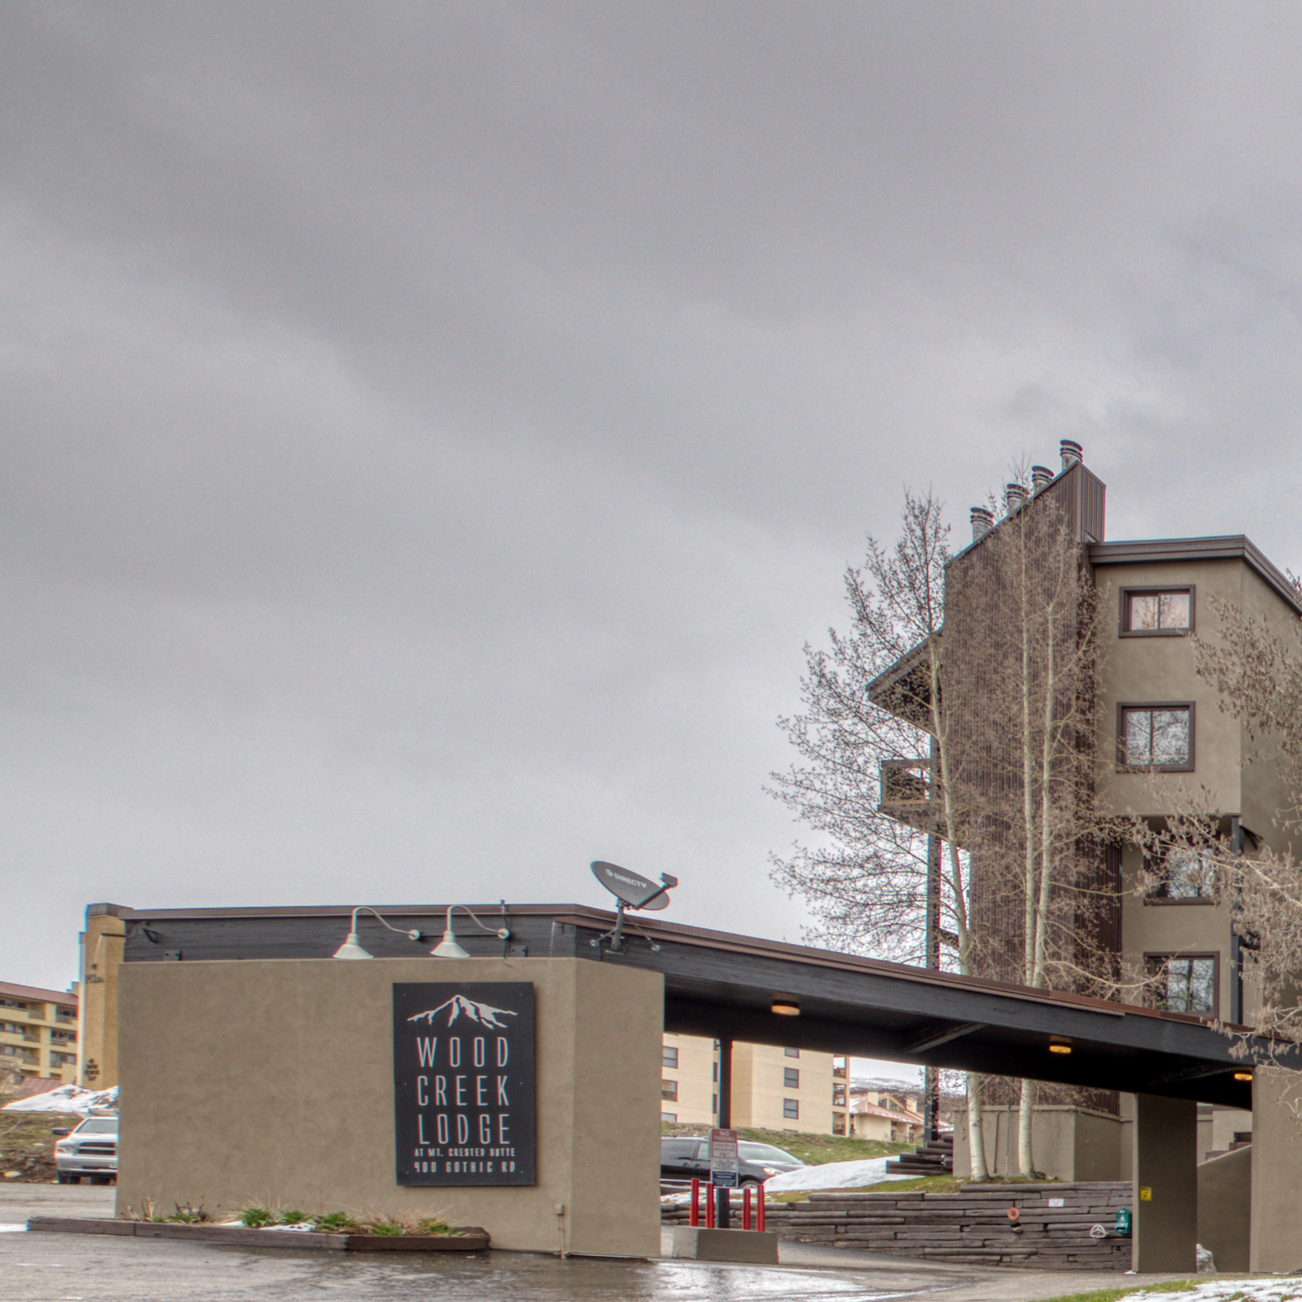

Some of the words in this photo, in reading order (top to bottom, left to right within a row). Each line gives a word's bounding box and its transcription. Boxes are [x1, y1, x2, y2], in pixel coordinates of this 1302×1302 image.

[416, 1036, 509, 1068] WOOD
[416, 1075, 510, 1106] CREEK
[417, 1113, 510, 1145] LODGE
[414, 1148, 424, 1157] AT
[428, 1148, 444, 1157] MT.
[448, 1148, 485, 1157] CRESTED
[489, 1148, 516, 1157] BUTTE
[414, 1161, 437, 1173] 400
[446, 1161, 493, 1173] GOTHIC
[502, 1161, 516, 1173] RD
